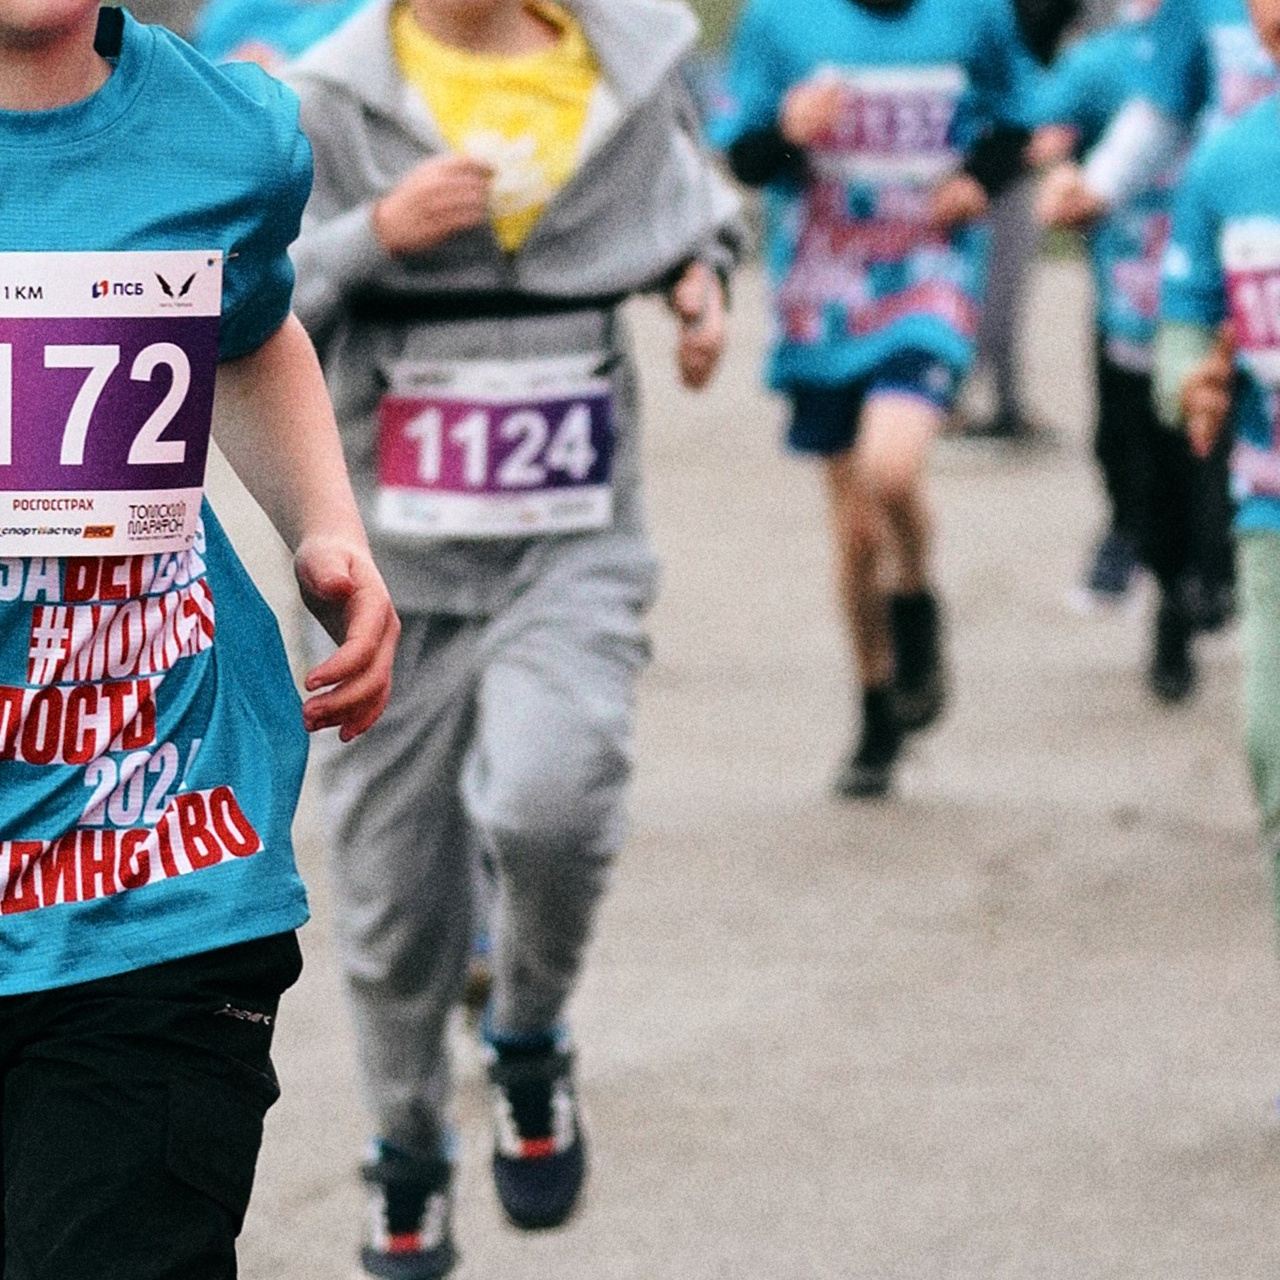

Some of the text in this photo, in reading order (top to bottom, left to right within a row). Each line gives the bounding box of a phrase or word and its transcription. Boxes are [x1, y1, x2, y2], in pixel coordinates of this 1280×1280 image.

[4, 286, 9, 299] 1
[113, 282, 144, 295] ПСБ
[402, 403, 598, 487] 1124
[12, 499, 94, 511] РОСГОССТРАХ
